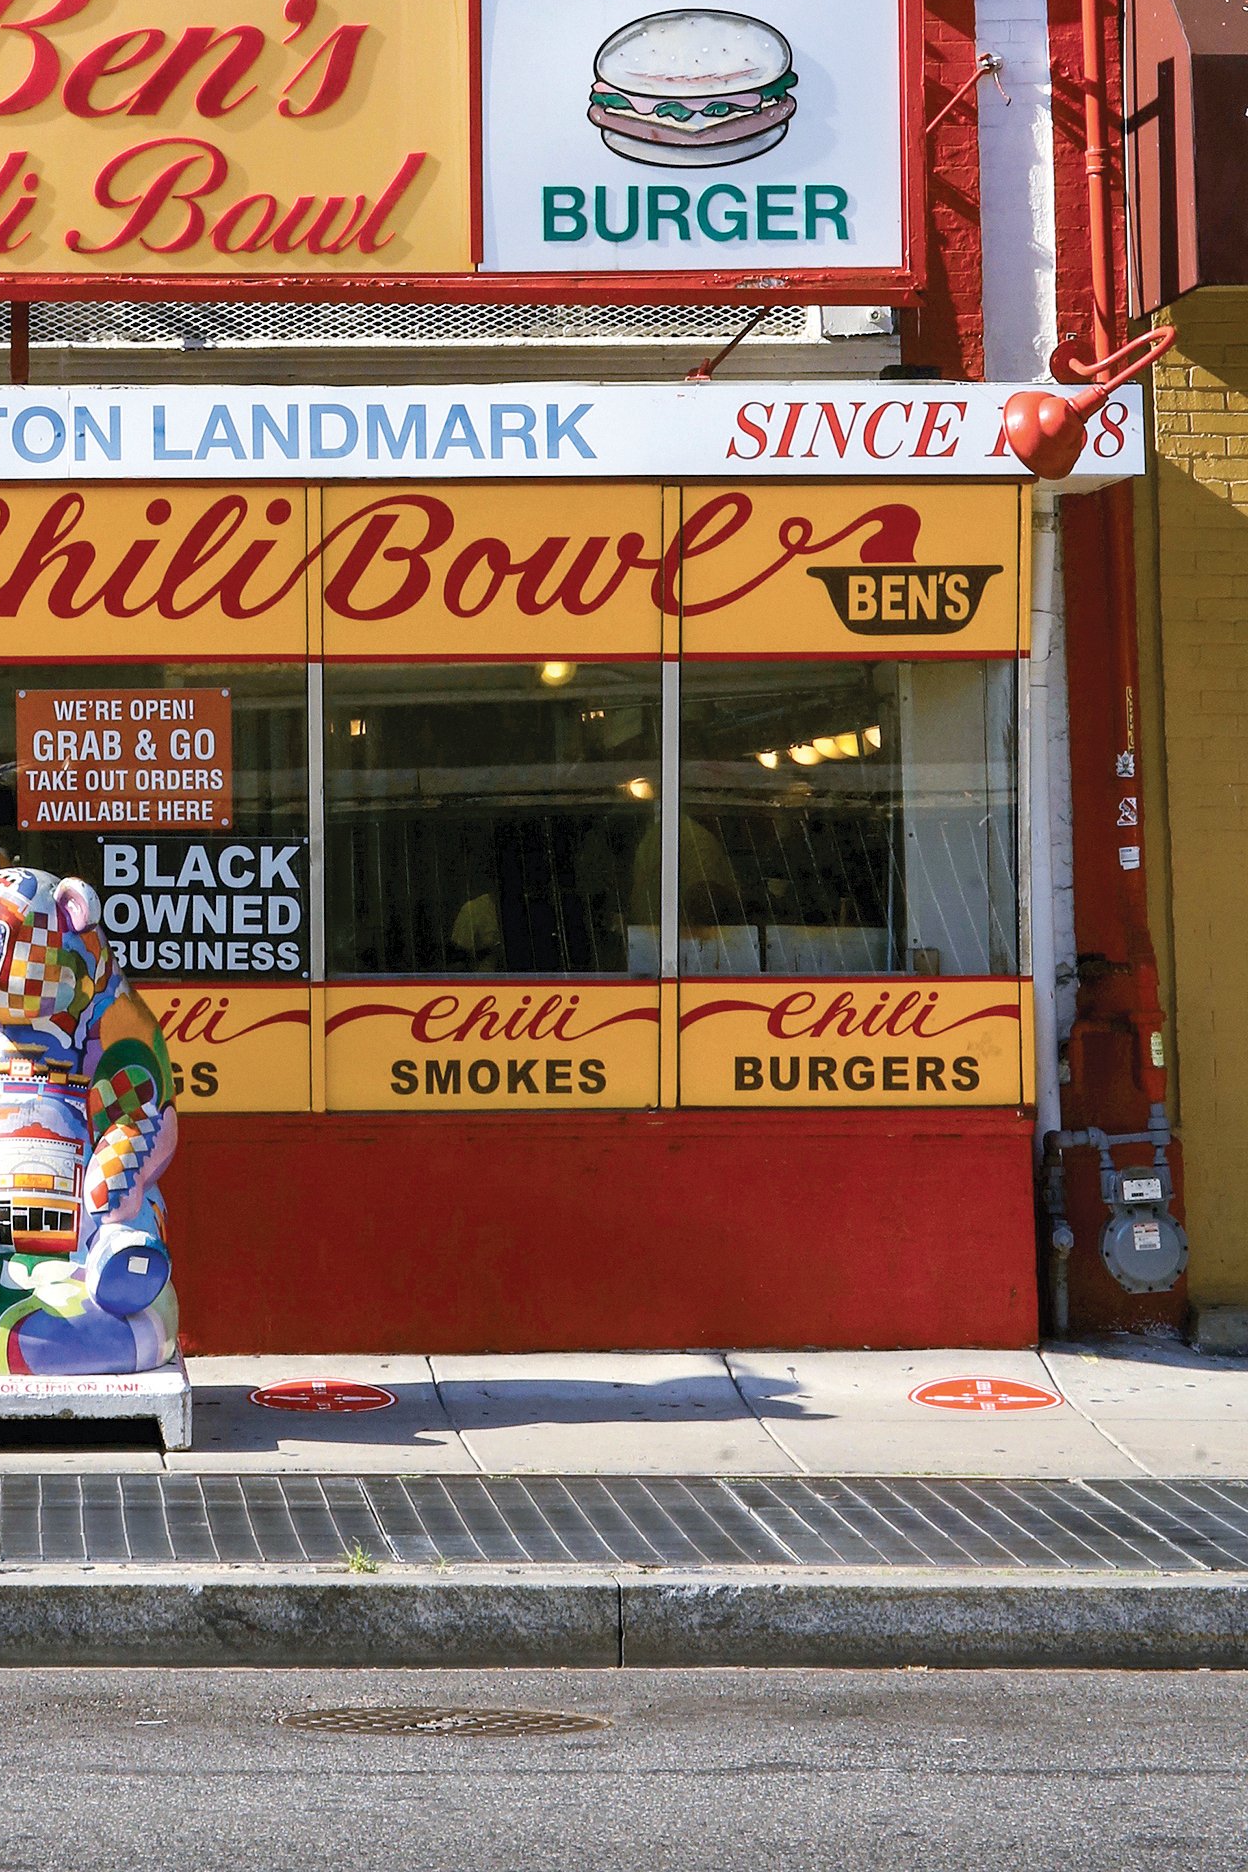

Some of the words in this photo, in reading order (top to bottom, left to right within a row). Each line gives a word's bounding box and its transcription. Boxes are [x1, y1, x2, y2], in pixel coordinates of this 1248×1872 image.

[64, 136, 428, 256] Bowl
[541, 183, 851, 244] BURGER
[154, 403, 599, 461] LANDMARK
[726, 400, 969, 460] SINCE
[984, 402, 1129, 458] 18
[324, 491, 755, 622] Bowl
[847, 573, 971, 622] BEN'S
[53, 700, 123, 721] WE'RE
[129, 699, 195, 721] OPEN!
[33, 730, 123, 763] GRAB
[134, 729, 158, 762] &
[170, 728, 216, 762] GO
[25, 770, 79, 792] TAKE
[85, 770, 130, 792] OUT
[135, 769, 225, 792] ORDERS
[36, 800, 152, 823] AVAILABLE
[157, 800, 214, 822] HERE
[103, 844, 301, 889] BLACK
[103, 893, 302, 935] OWNED
[108, 940, 301, 971] BUSINESS
[410, 993, 582, 1043] Chili
[765, 991, 940, 1040] Chili
[390, 1058, 608, 1096] SMOKES
[735, 1056, 981, 1093] BURGERS
[0, 1384, 21, 1393] OR
[77, 1384, 98, 1393] ON
[105, 1382, 151, 1393] PAN
